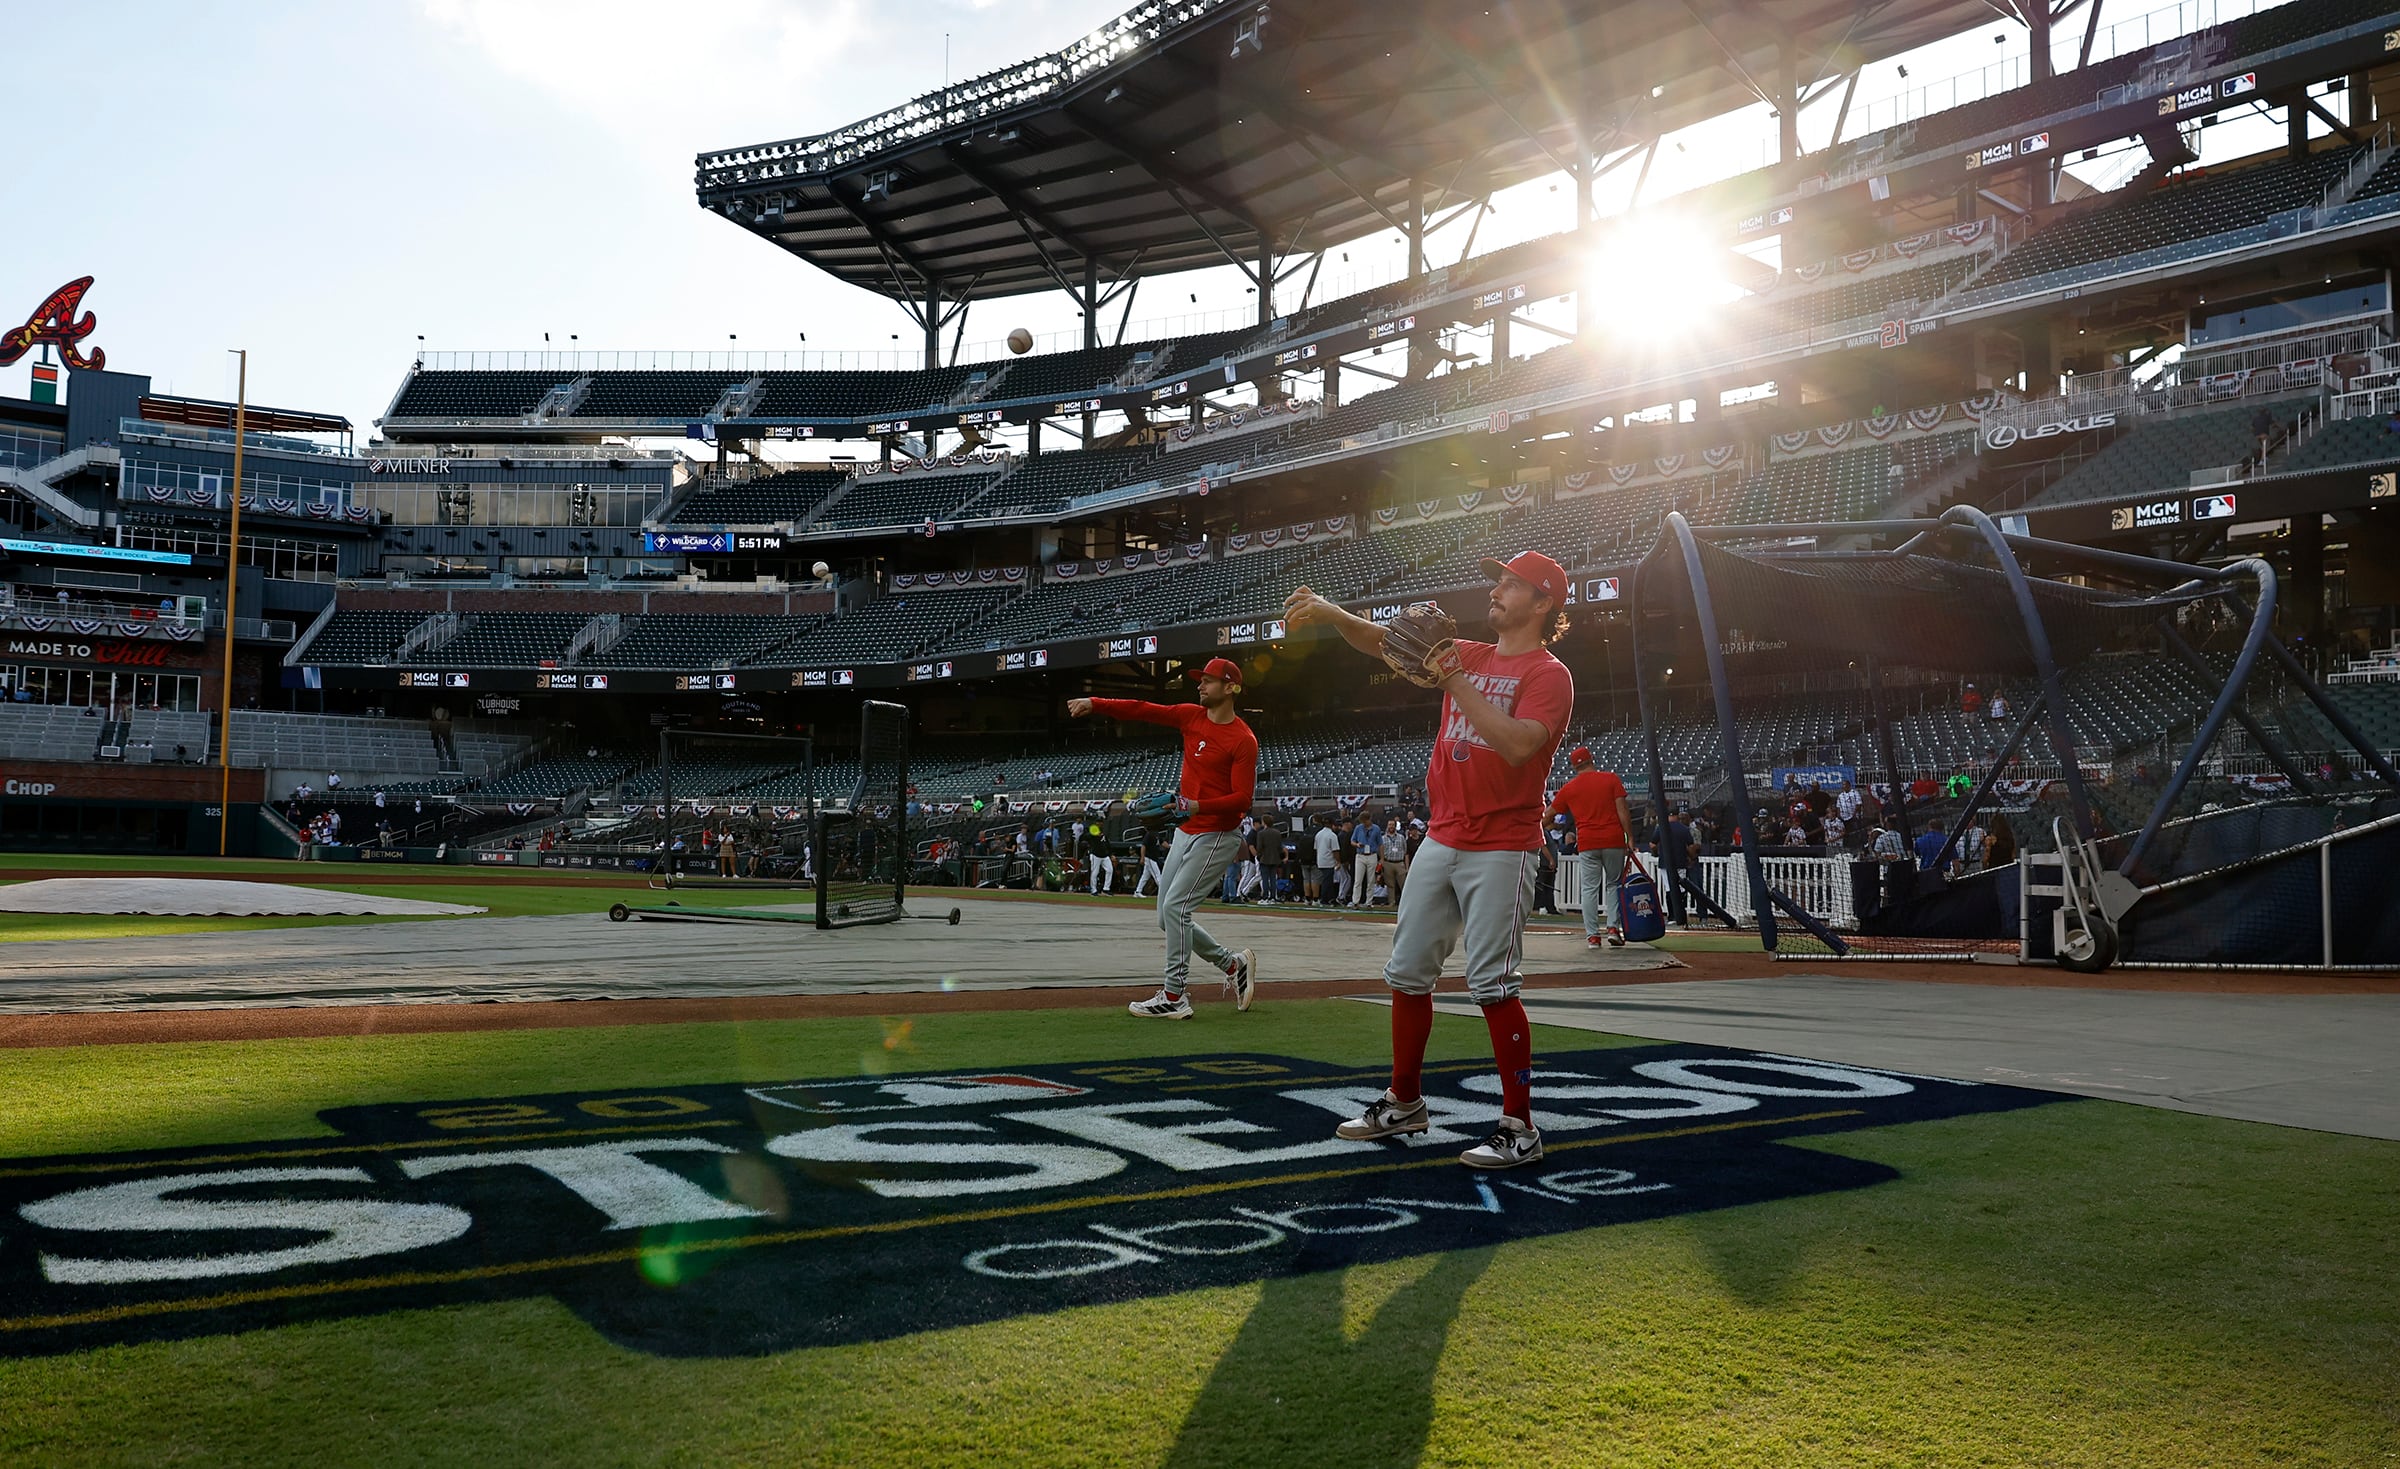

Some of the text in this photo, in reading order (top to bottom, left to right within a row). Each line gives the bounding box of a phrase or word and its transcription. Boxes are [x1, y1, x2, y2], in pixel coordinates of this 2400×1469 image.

[2178, 85, 2212, 104] MGM
[2178, 97, 2213, 111] REWARDS
[1982, 142, 2012, 160] MGM
[1483, 291, 1503, 302] MGM
[1377, 322, 1395, 333] MGM
[1846, 318, 1936, 349] WARREN 21 SPAHN
[1467, 421, 1489, 432] CHIPPER
[1489, 409, 1509, 434] 10
[2020, 413, 2116, 441] LEXUS
[385, 458, 451, 473] MILNER
[1199, 477, 1209, 496] 6
[2136, 501, 2180, 519] MGM
[2136, 516, 2181, 527] REWARDS
[925, 521, 936, 538] 3
[738, 538, 780, 548] 5:51 PM
[1372, 606, 1400, 620] MGM
[1230, 624, 1255, 636] MGM
[1110, 640, 1132, 651] MGM
[1231, 635, 1256, 643] REWARDS
[8, 640, 173, 666] MADE TO Chill
[1006, 653, 1025, 664] MGM
[804, 671, 826, 681] MGM
[916, 664, 933, 674] MGM
[413, 673, 439, 681] MGM
[551, 675, 577, 683] MGM
[689, 676, 710, 684] MGM
[5, 779, 56, 796] CHOP
[205, 808, 222, 817] 325
[370, 850, 403, 859] BETMGM
[416, 1096, 712, 1130] 20
[20, 1053, 1982, 1284] STSEASO
[963, 1166, 1673, 1280] abbvie
